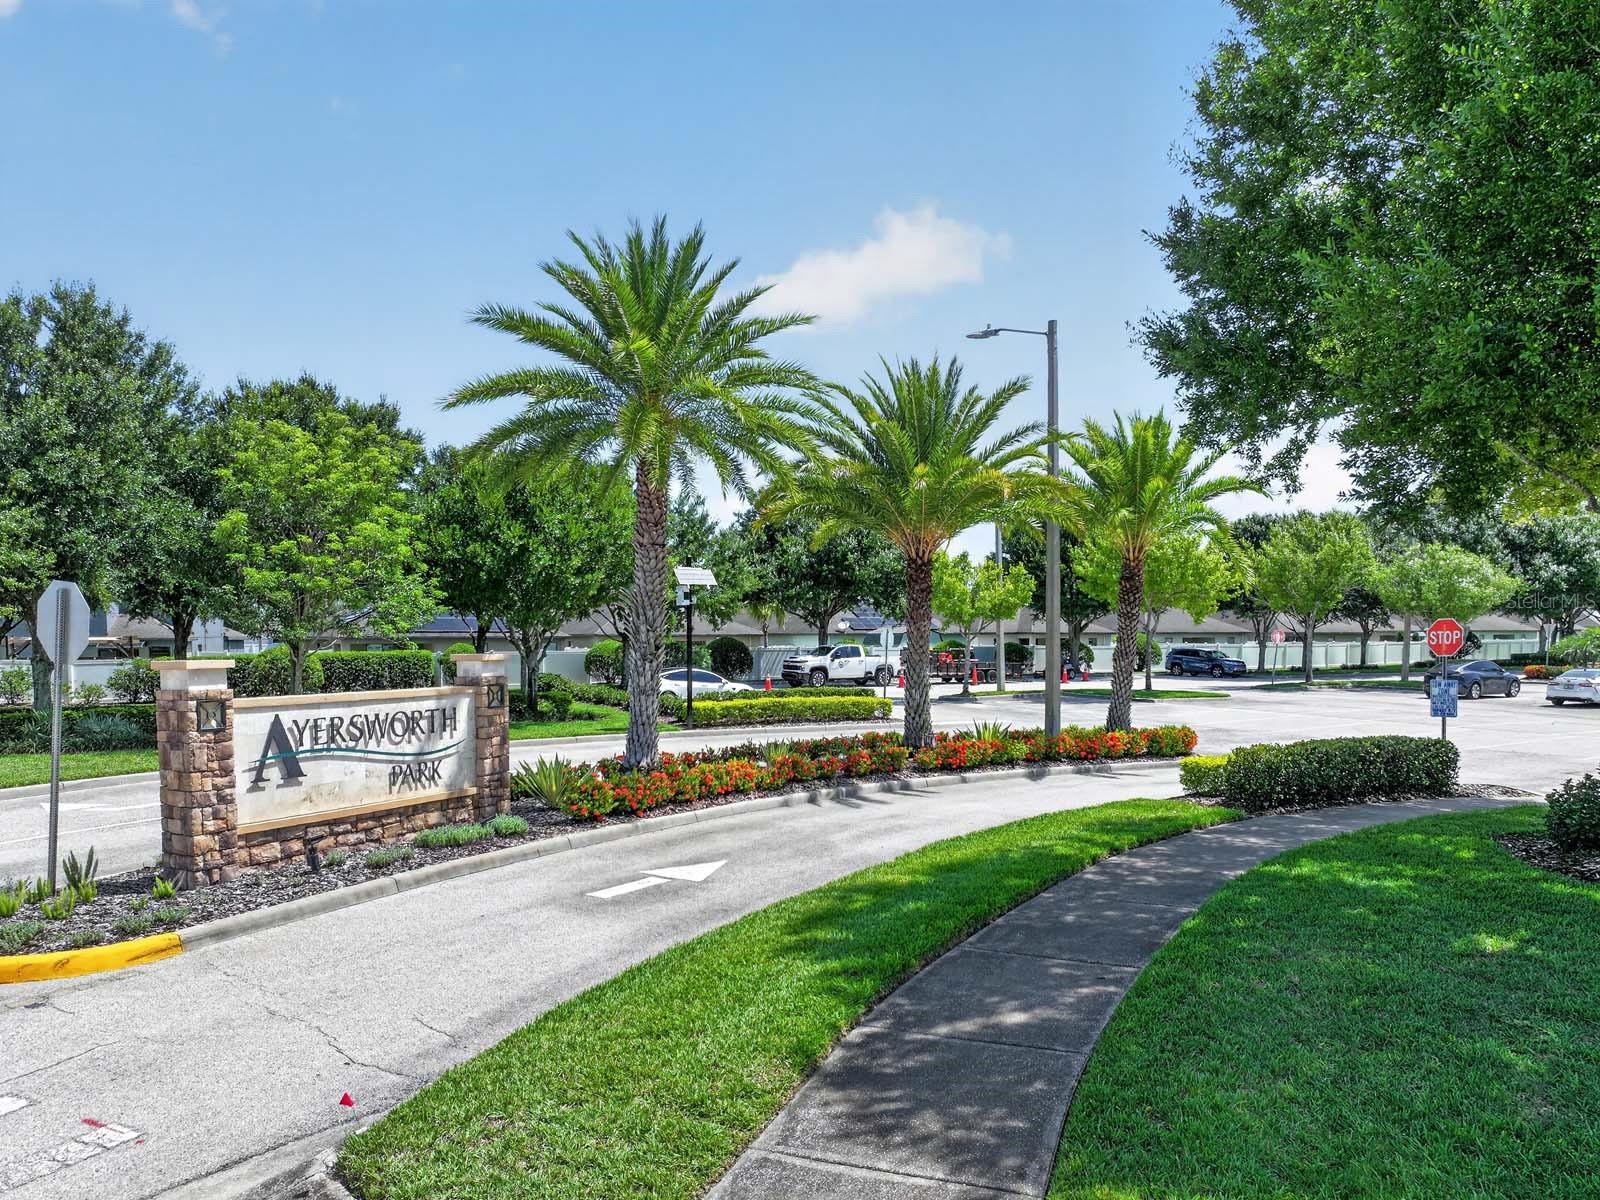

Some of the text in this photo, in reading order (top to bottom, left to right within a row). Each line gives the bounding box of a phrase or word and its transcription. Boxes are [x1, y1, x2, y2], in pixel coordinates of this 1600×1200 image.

[1430, 630, 1460, 645] STOP
[250, 707, 457, 783] AYERSWORTH
[391, 760, 442, 785] PARK
